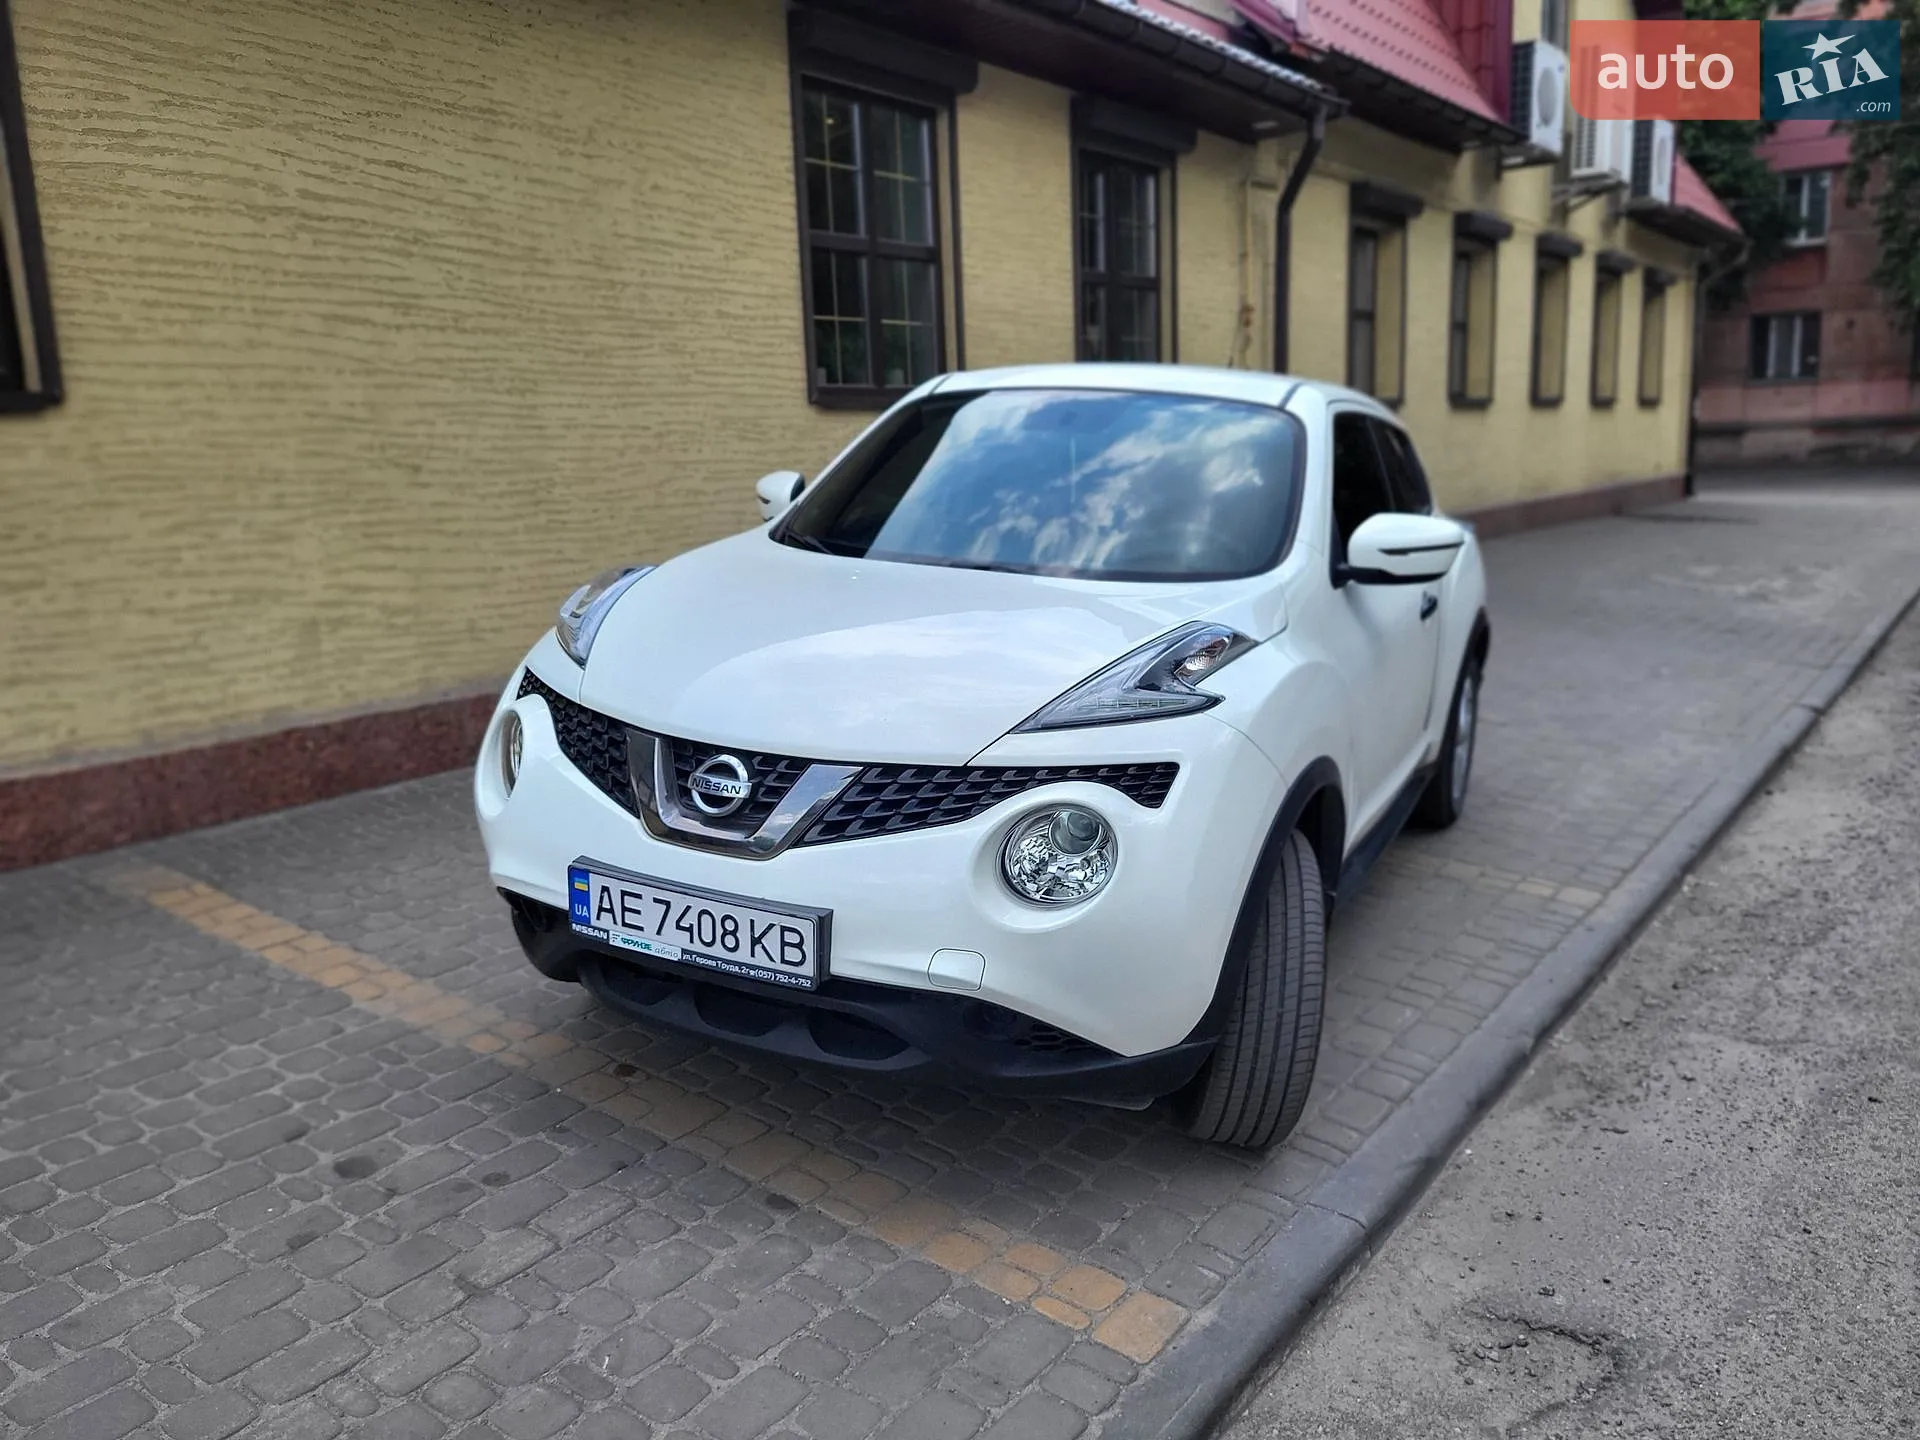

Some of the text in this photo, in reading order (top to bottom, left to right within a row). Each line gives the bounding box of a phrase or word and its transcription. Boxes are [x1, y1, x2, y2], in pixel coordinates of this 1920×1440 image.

[692, 777, 742, 795] NISSAN
[574, 903, 590, 919] UA
[571, 922, 608, 941] NISSAN
[595, 885, 807, 967] AE 7408 KB
